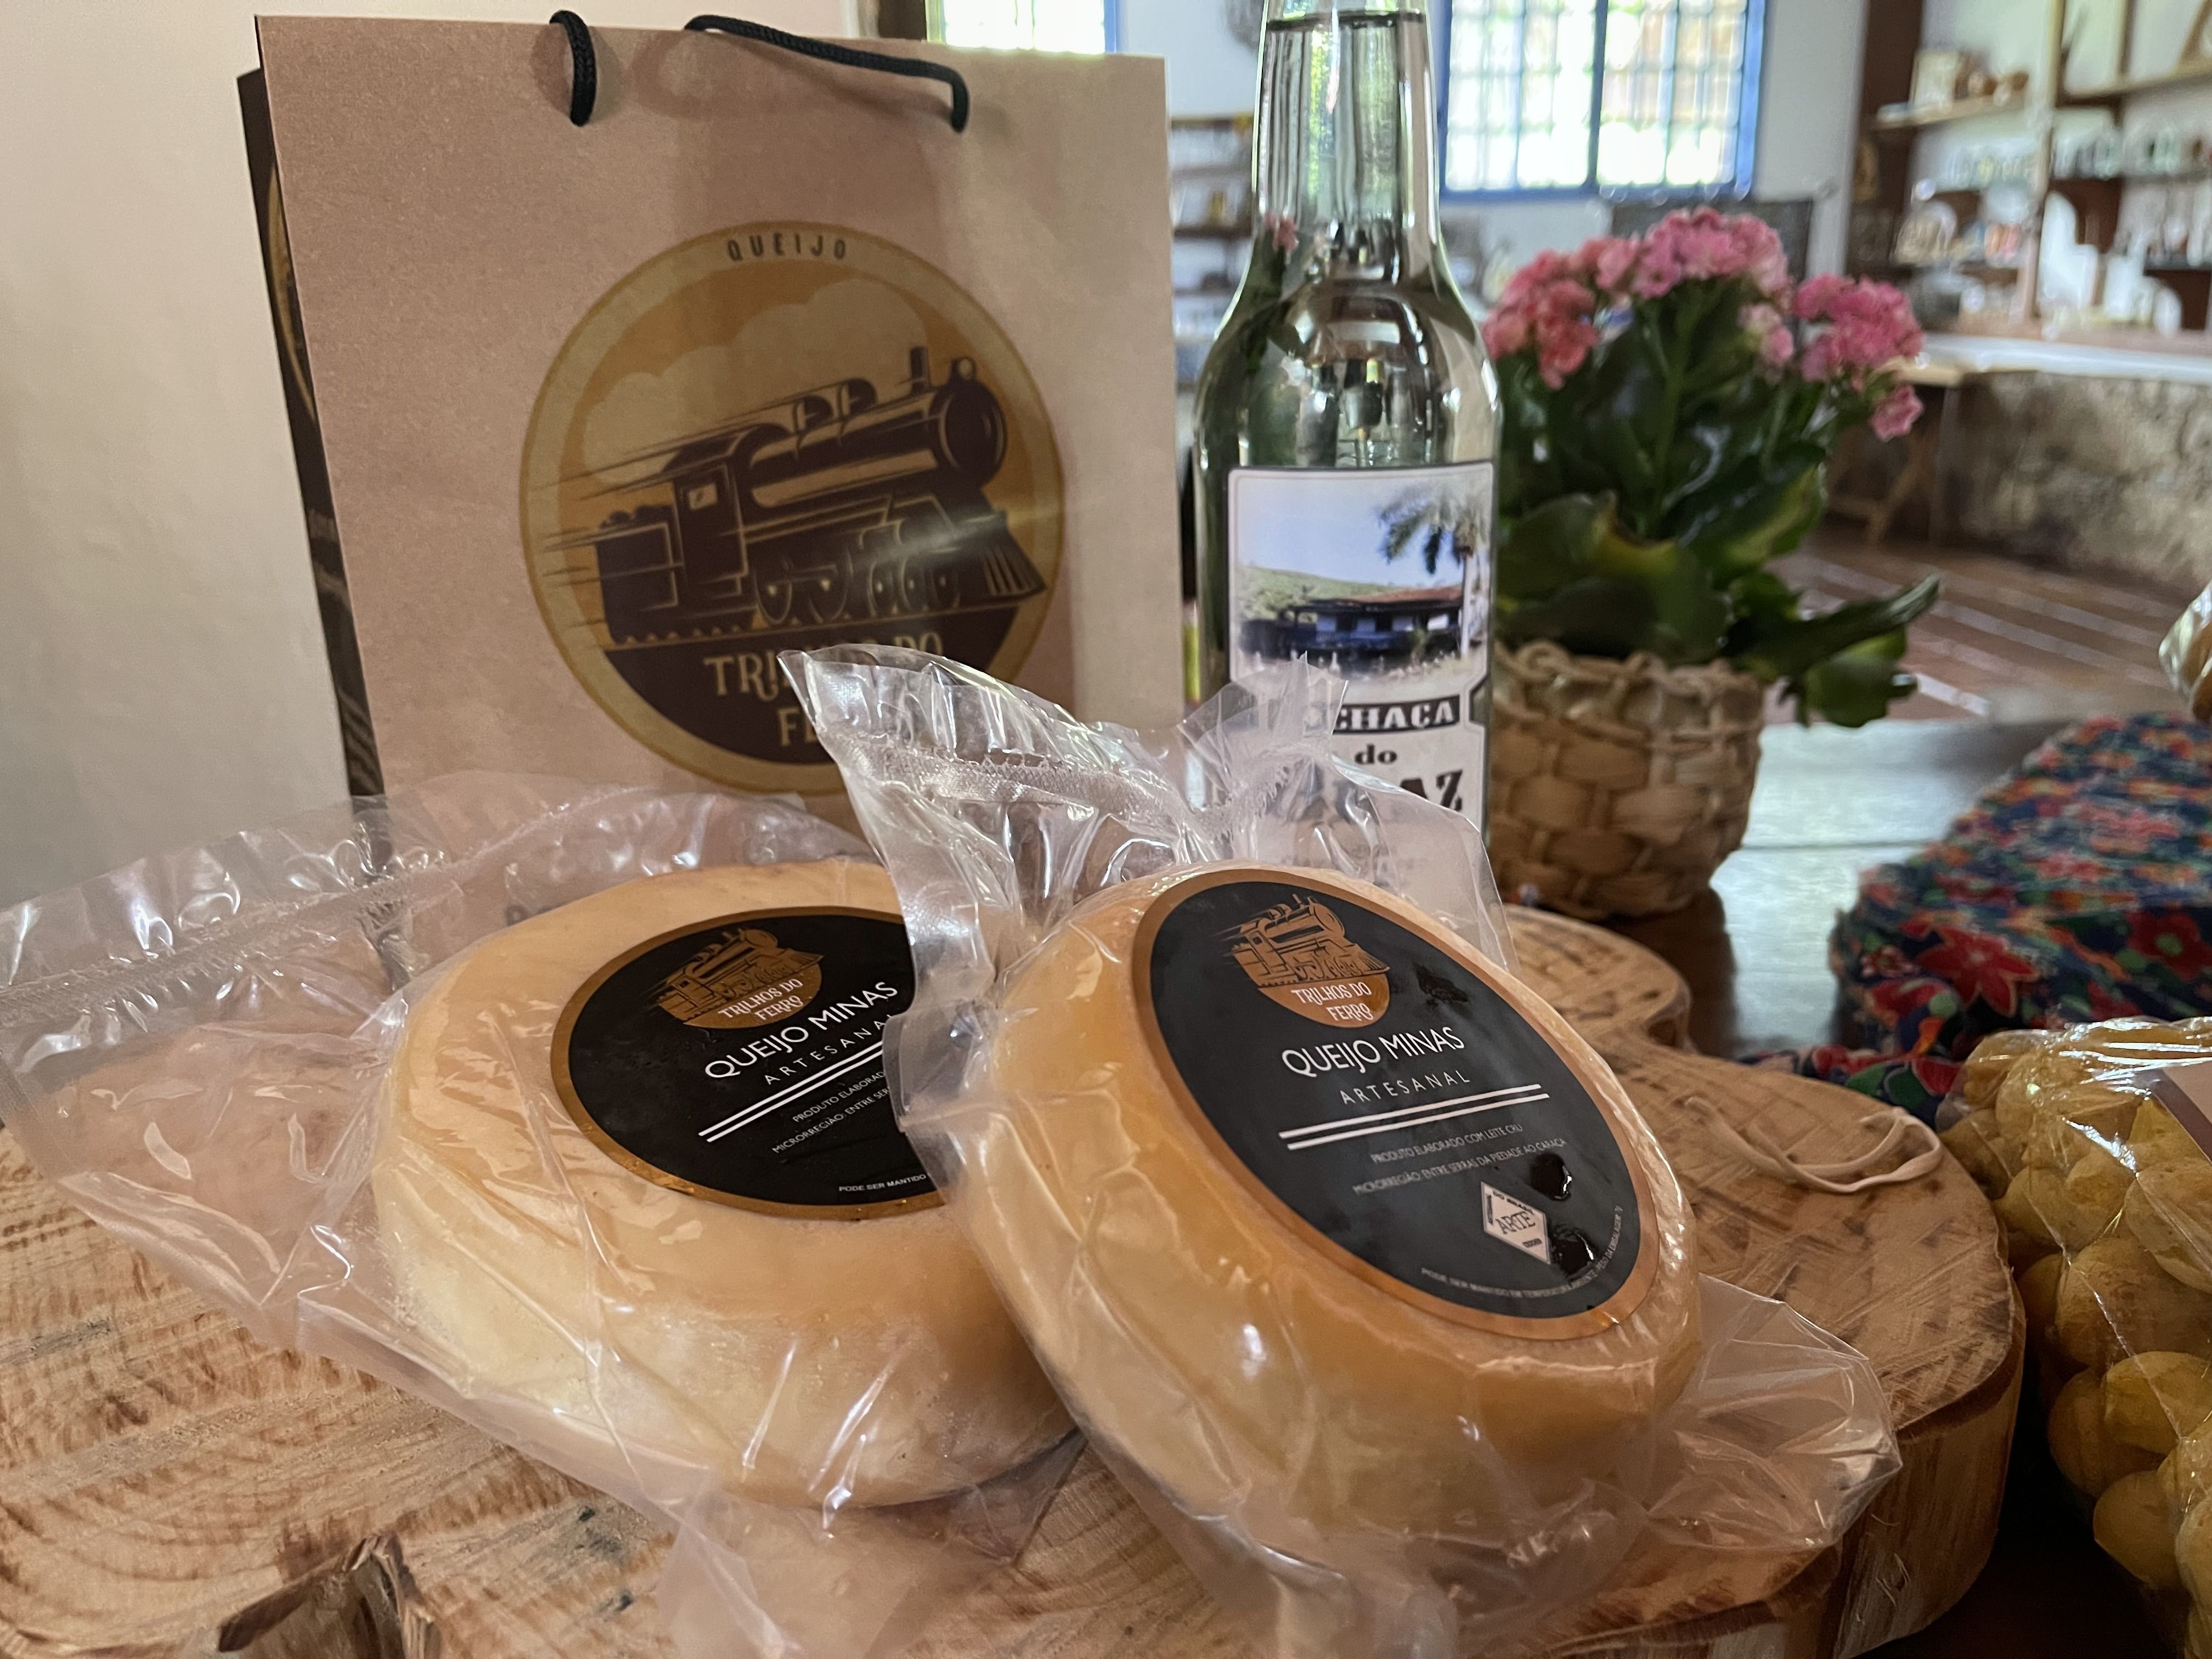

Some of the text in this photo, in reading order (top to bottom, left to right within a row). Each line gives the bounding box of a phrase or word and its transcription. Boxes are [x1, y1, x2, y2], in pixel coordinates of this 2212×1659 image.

[726, 232, 846, 262] QUEIJO
[1354, 743, 1398, 765] do
[717, 978, 804, 1018] TRILHOS DO
[754, 995, 804, 1020] FERRO
[1290, 981, 1372, 1006] TRILHOS DO
[1325, 1002, 1374, 1022] FERRO
[704, 981, 898, 1079] QUEIJO MINAS
[1282, 1026, 1465, 1077] QUEIJO MINAS
[792, 1071, 885, 1122] PRODUTO ELABORAD
[1339, 1070, 1470, 1105] ARTESANAL
[844, 1096, 876, 1115] ENTRE
[1370, 1123, 1523, 1164] PRODUTO ELABORADO COM LEITE CRU
[1420, 1164, 1450, 1179] ENTRE
[1448, 1158, 1479, 1175] SERRAS
[1477, 1155, 1493, 1166] DA
[1489, 1146, 1524, 1161] PIEDADE
[1522, 1143, 1537, 1154] AO
[1536, 1137, 1567, 1151] CARAÇA
[887, 1173, 927, 1187] MANTIDO
[1495, 1211, 1536, 1234] ARTE
